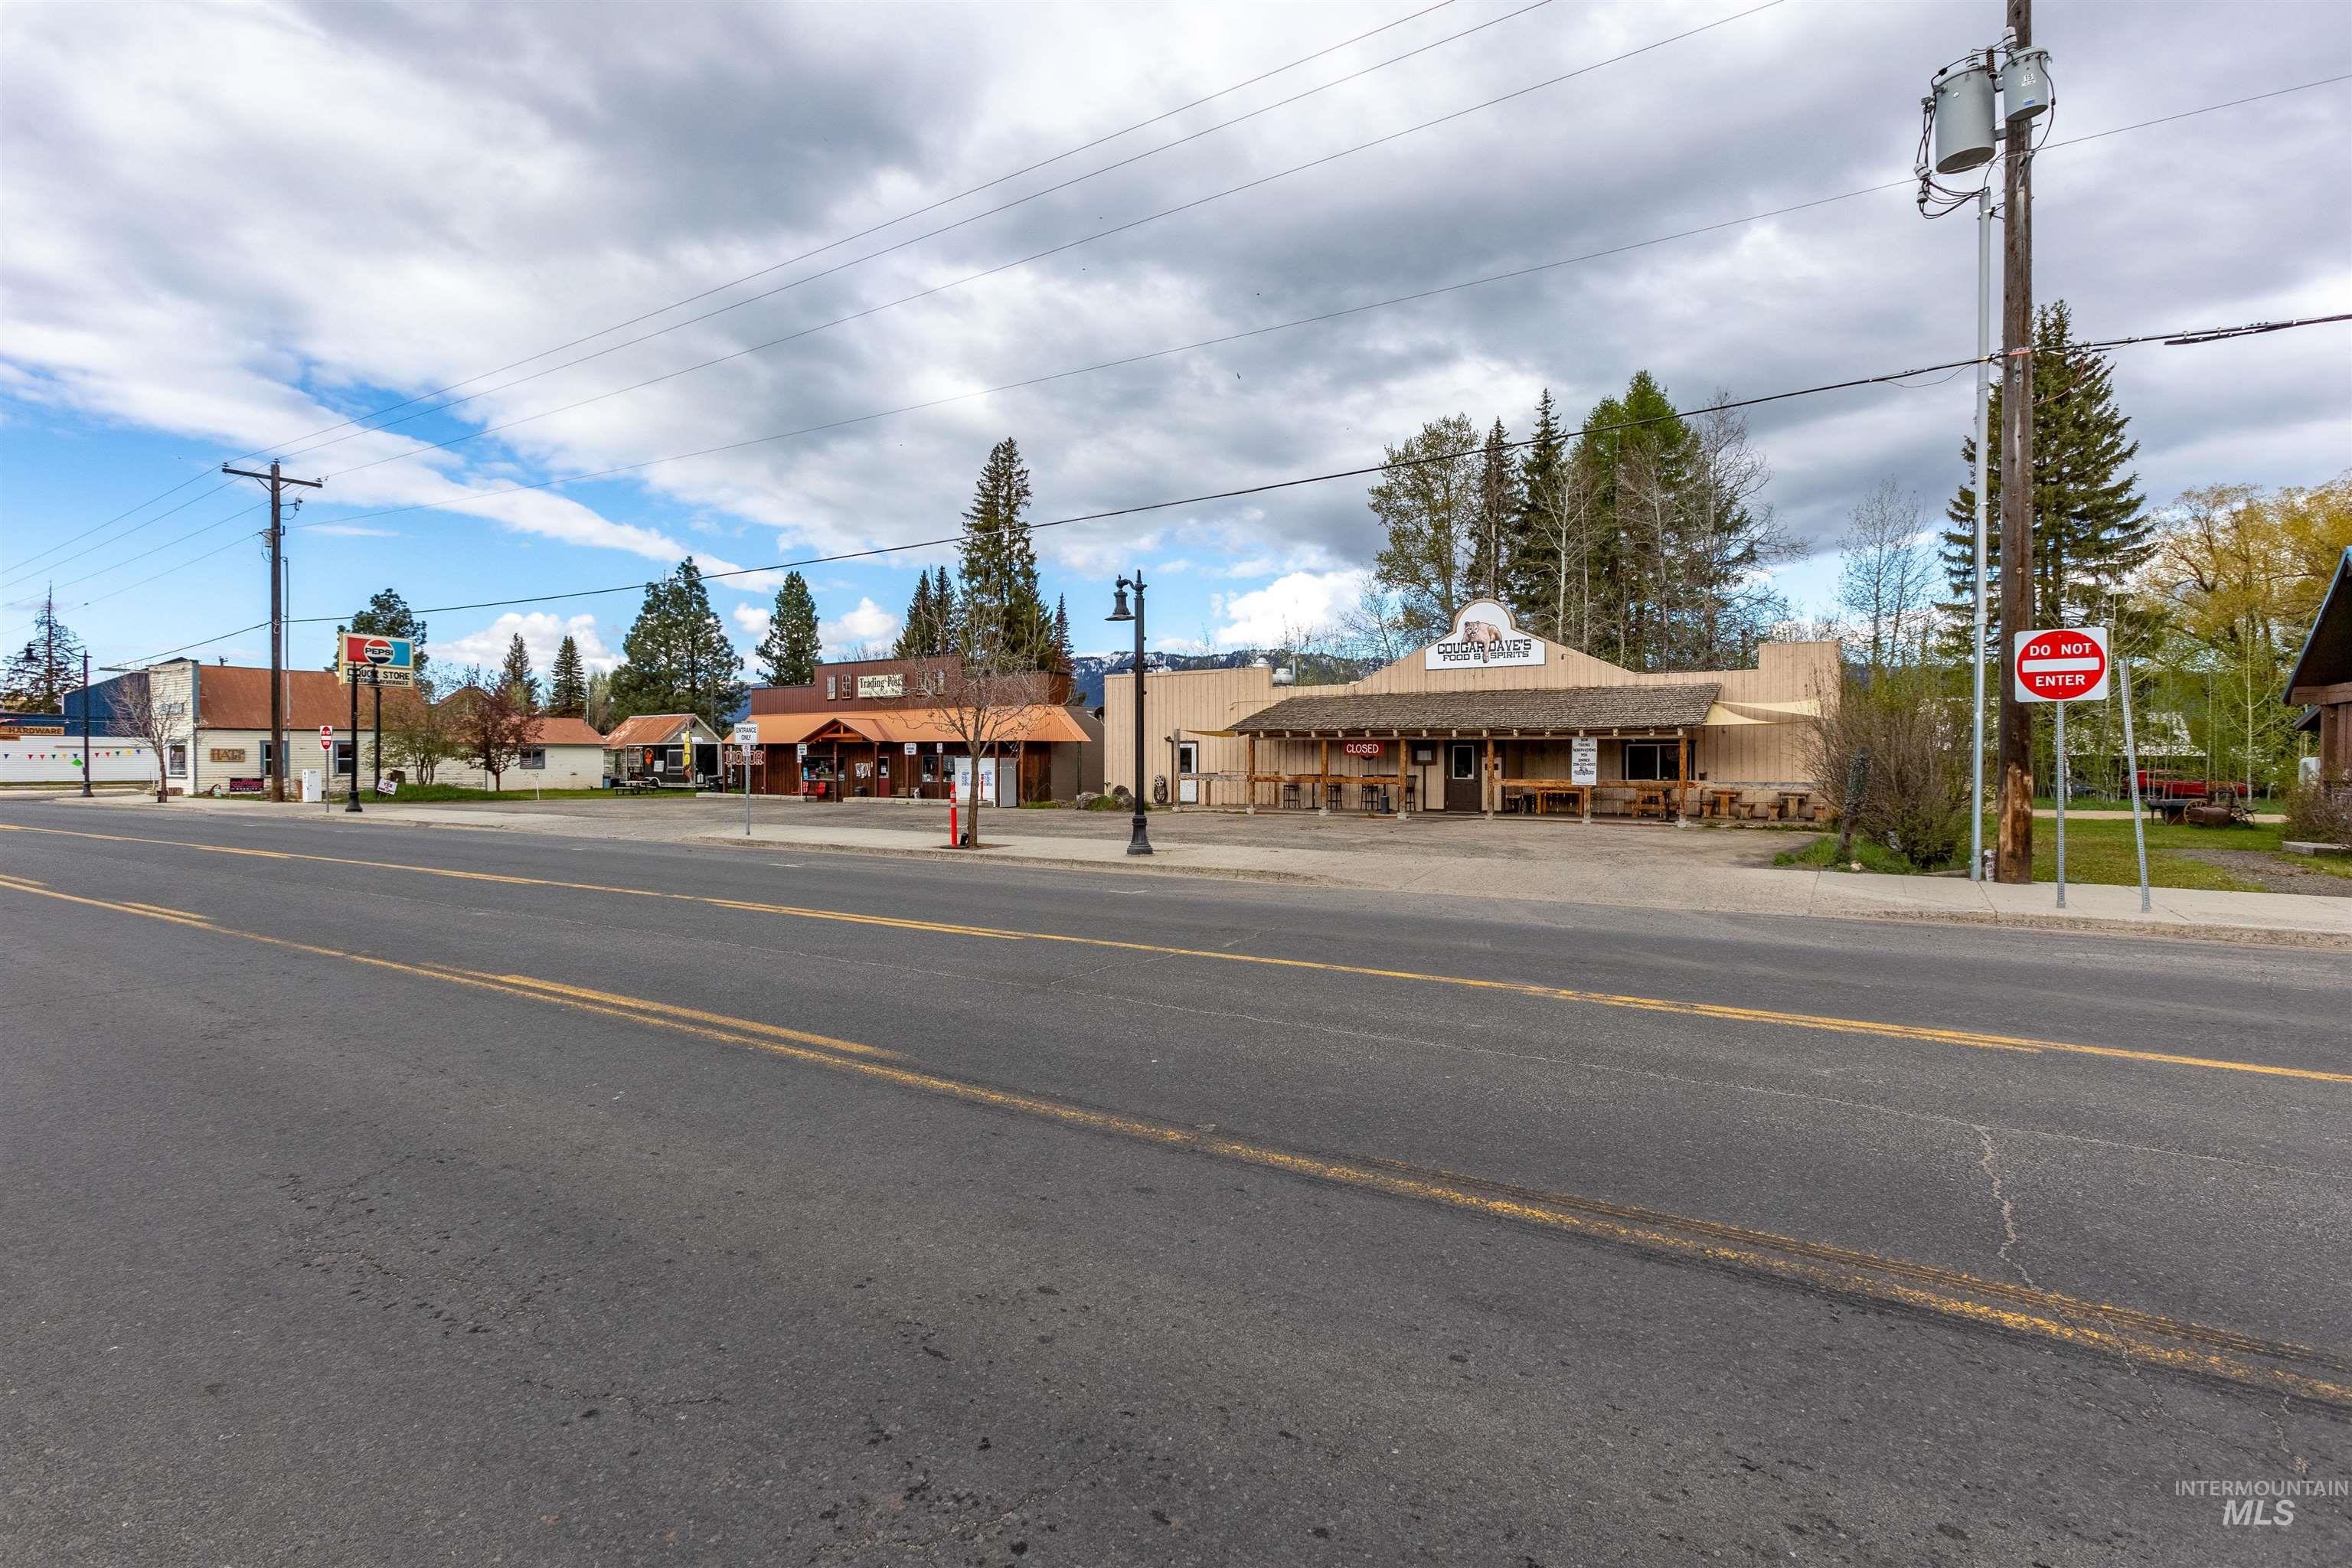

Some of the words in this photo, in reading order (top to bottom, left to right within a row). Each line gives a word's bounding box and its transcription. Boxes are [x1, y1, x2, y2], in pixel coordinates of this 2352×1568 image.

[365, 647, 394, 656] PEPSI
[1437, 642, 1485, 655] COUGAR
[1488, 639, 1532, 652] DAVE'S
[2029, 645, 2051, 657] DO
[2060, 642, 2092, 655] NOT
[1490, 651, 1529, 659] SPIRITS
[383, 671, 410, 680] STORE
[859, 677, 884, 691] Trading
[2035, 675, 2086, 687] ENTER
[8, 727, 63, 735] HARDWARE
[1346, 743, 1379, 753] CLOSED
